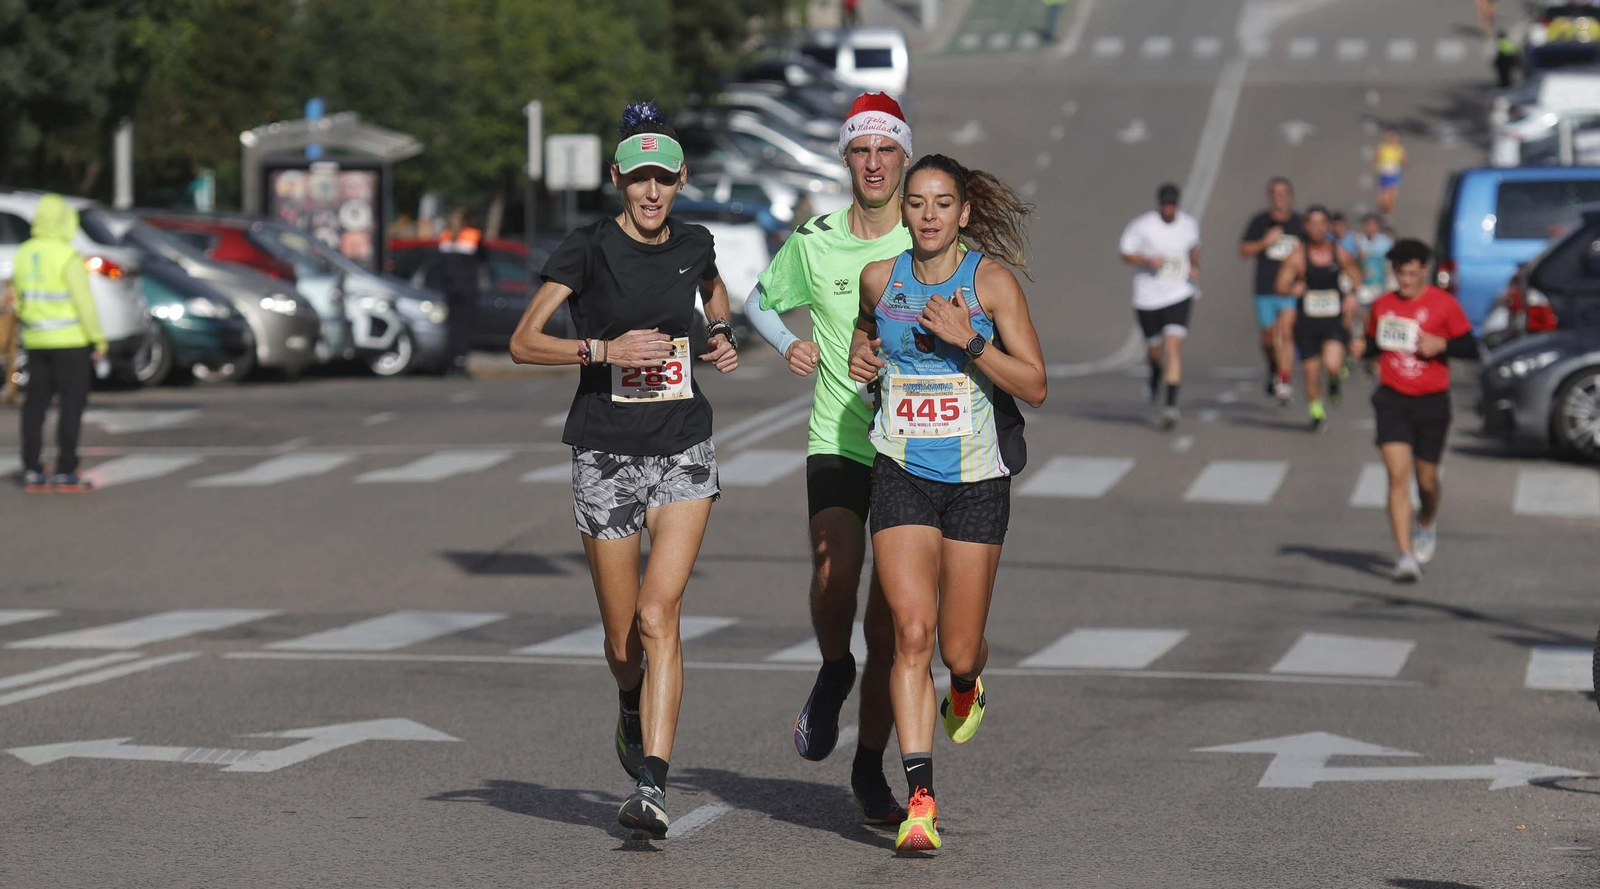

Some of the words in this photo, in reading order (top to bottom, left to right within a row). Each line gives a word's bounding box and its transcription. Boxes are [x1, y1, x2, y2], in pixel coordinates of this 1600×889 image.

[857, 124, 892, 134] Navidad
[863, 116, 887, 125] Feliz
[621, 361, 683, 387] 283
[896, 397, 960, 422] 445
